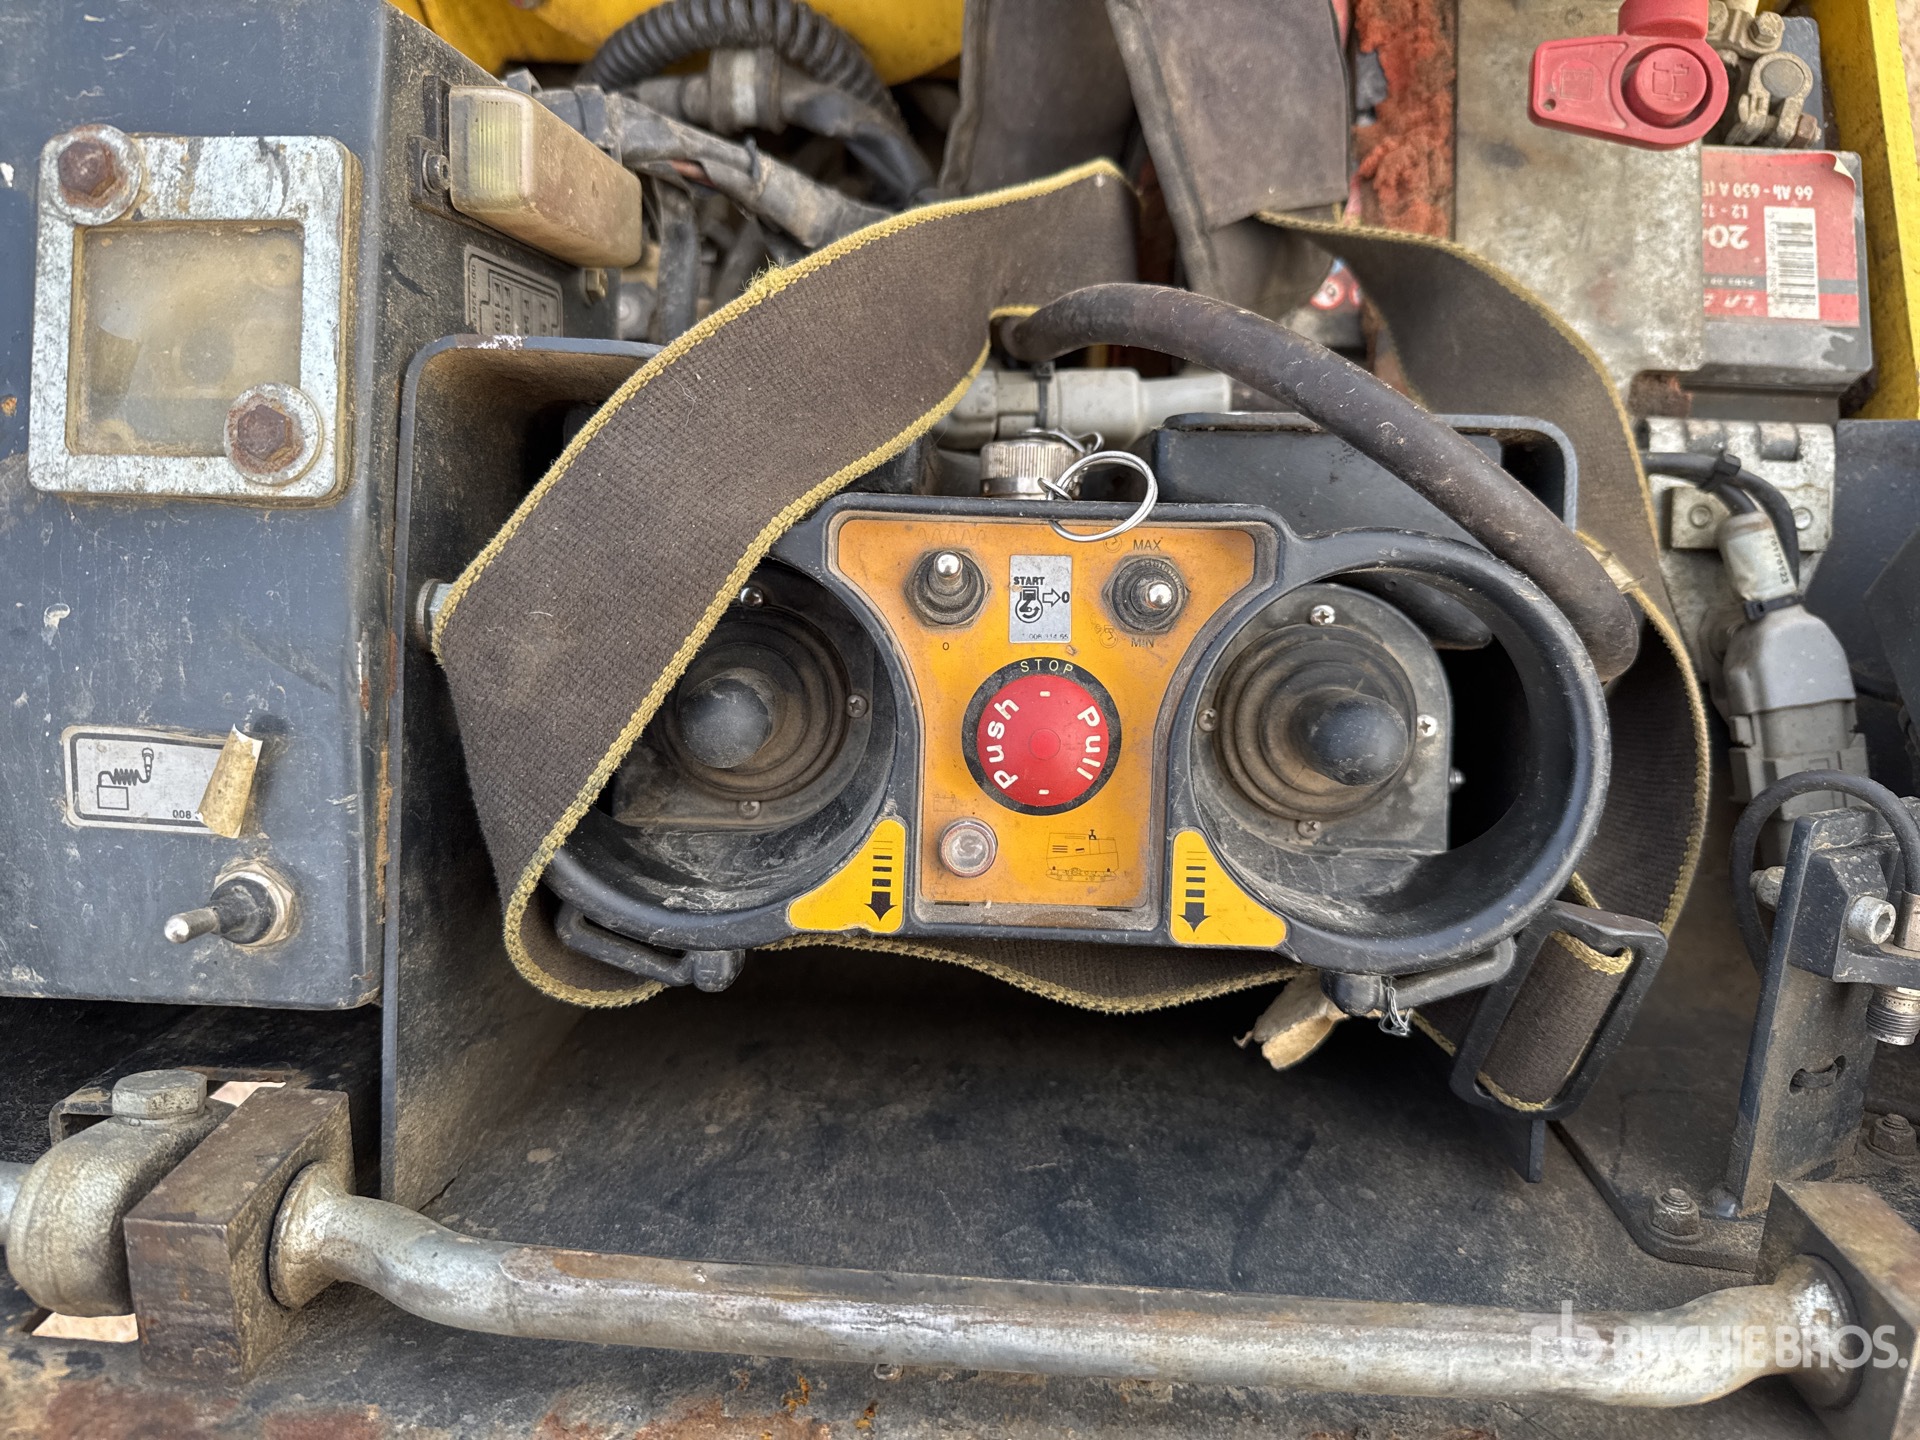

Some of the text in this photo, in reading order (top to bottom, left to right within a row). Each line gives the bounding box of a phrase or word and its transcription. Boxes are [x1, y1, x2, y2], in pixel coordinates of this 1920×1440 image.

[1795, 185, 1814, 200] 66
[1133, 539, 1161, 550] MAX
[1013, 576, 1045, 585] START
[1131, 637, 1155, 648] MIN
[1020, 659, 1073, 674] STOP
[986, 699, 1019, 789] Push
[1077, 705, 1101, 781] Pull
[172, 810, 192, 819] 008
